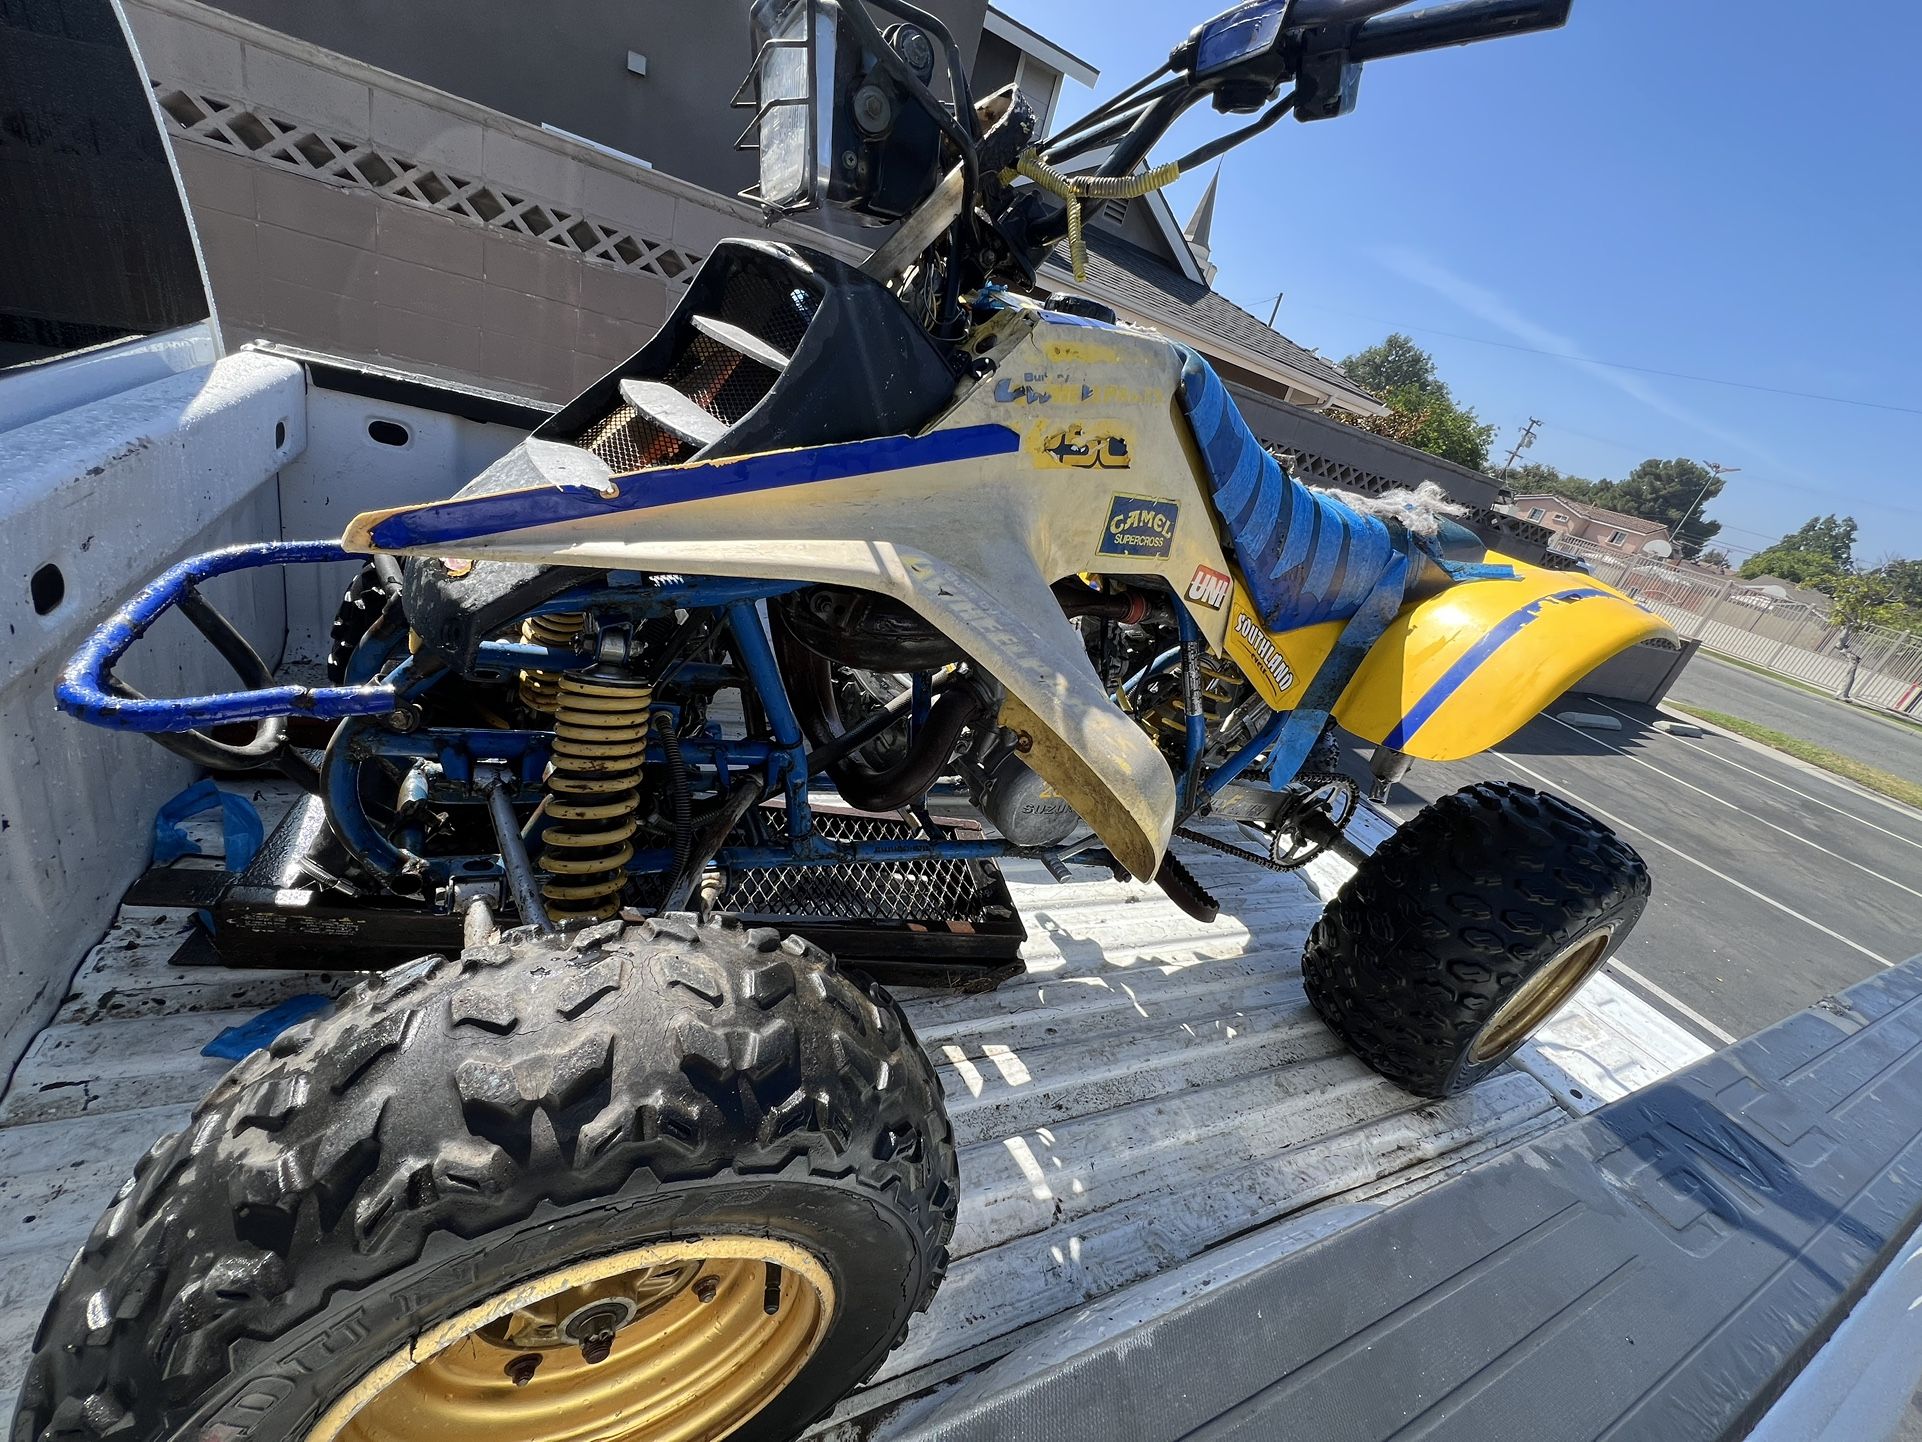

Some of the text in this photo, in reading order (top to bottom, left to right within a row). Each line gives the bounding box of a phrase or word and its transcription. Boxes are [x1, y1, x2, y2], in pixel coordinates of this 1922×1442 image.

[1110, 510, 1171, 539] CAMEL
[1114, 533, 1164, 547] SUPERCROSS
[1188, 571, 1228, 607] UNI
[1234, 612, 1294, 692] SOUTHLAND
[1251, 653, 1267, 675] CYCLE
